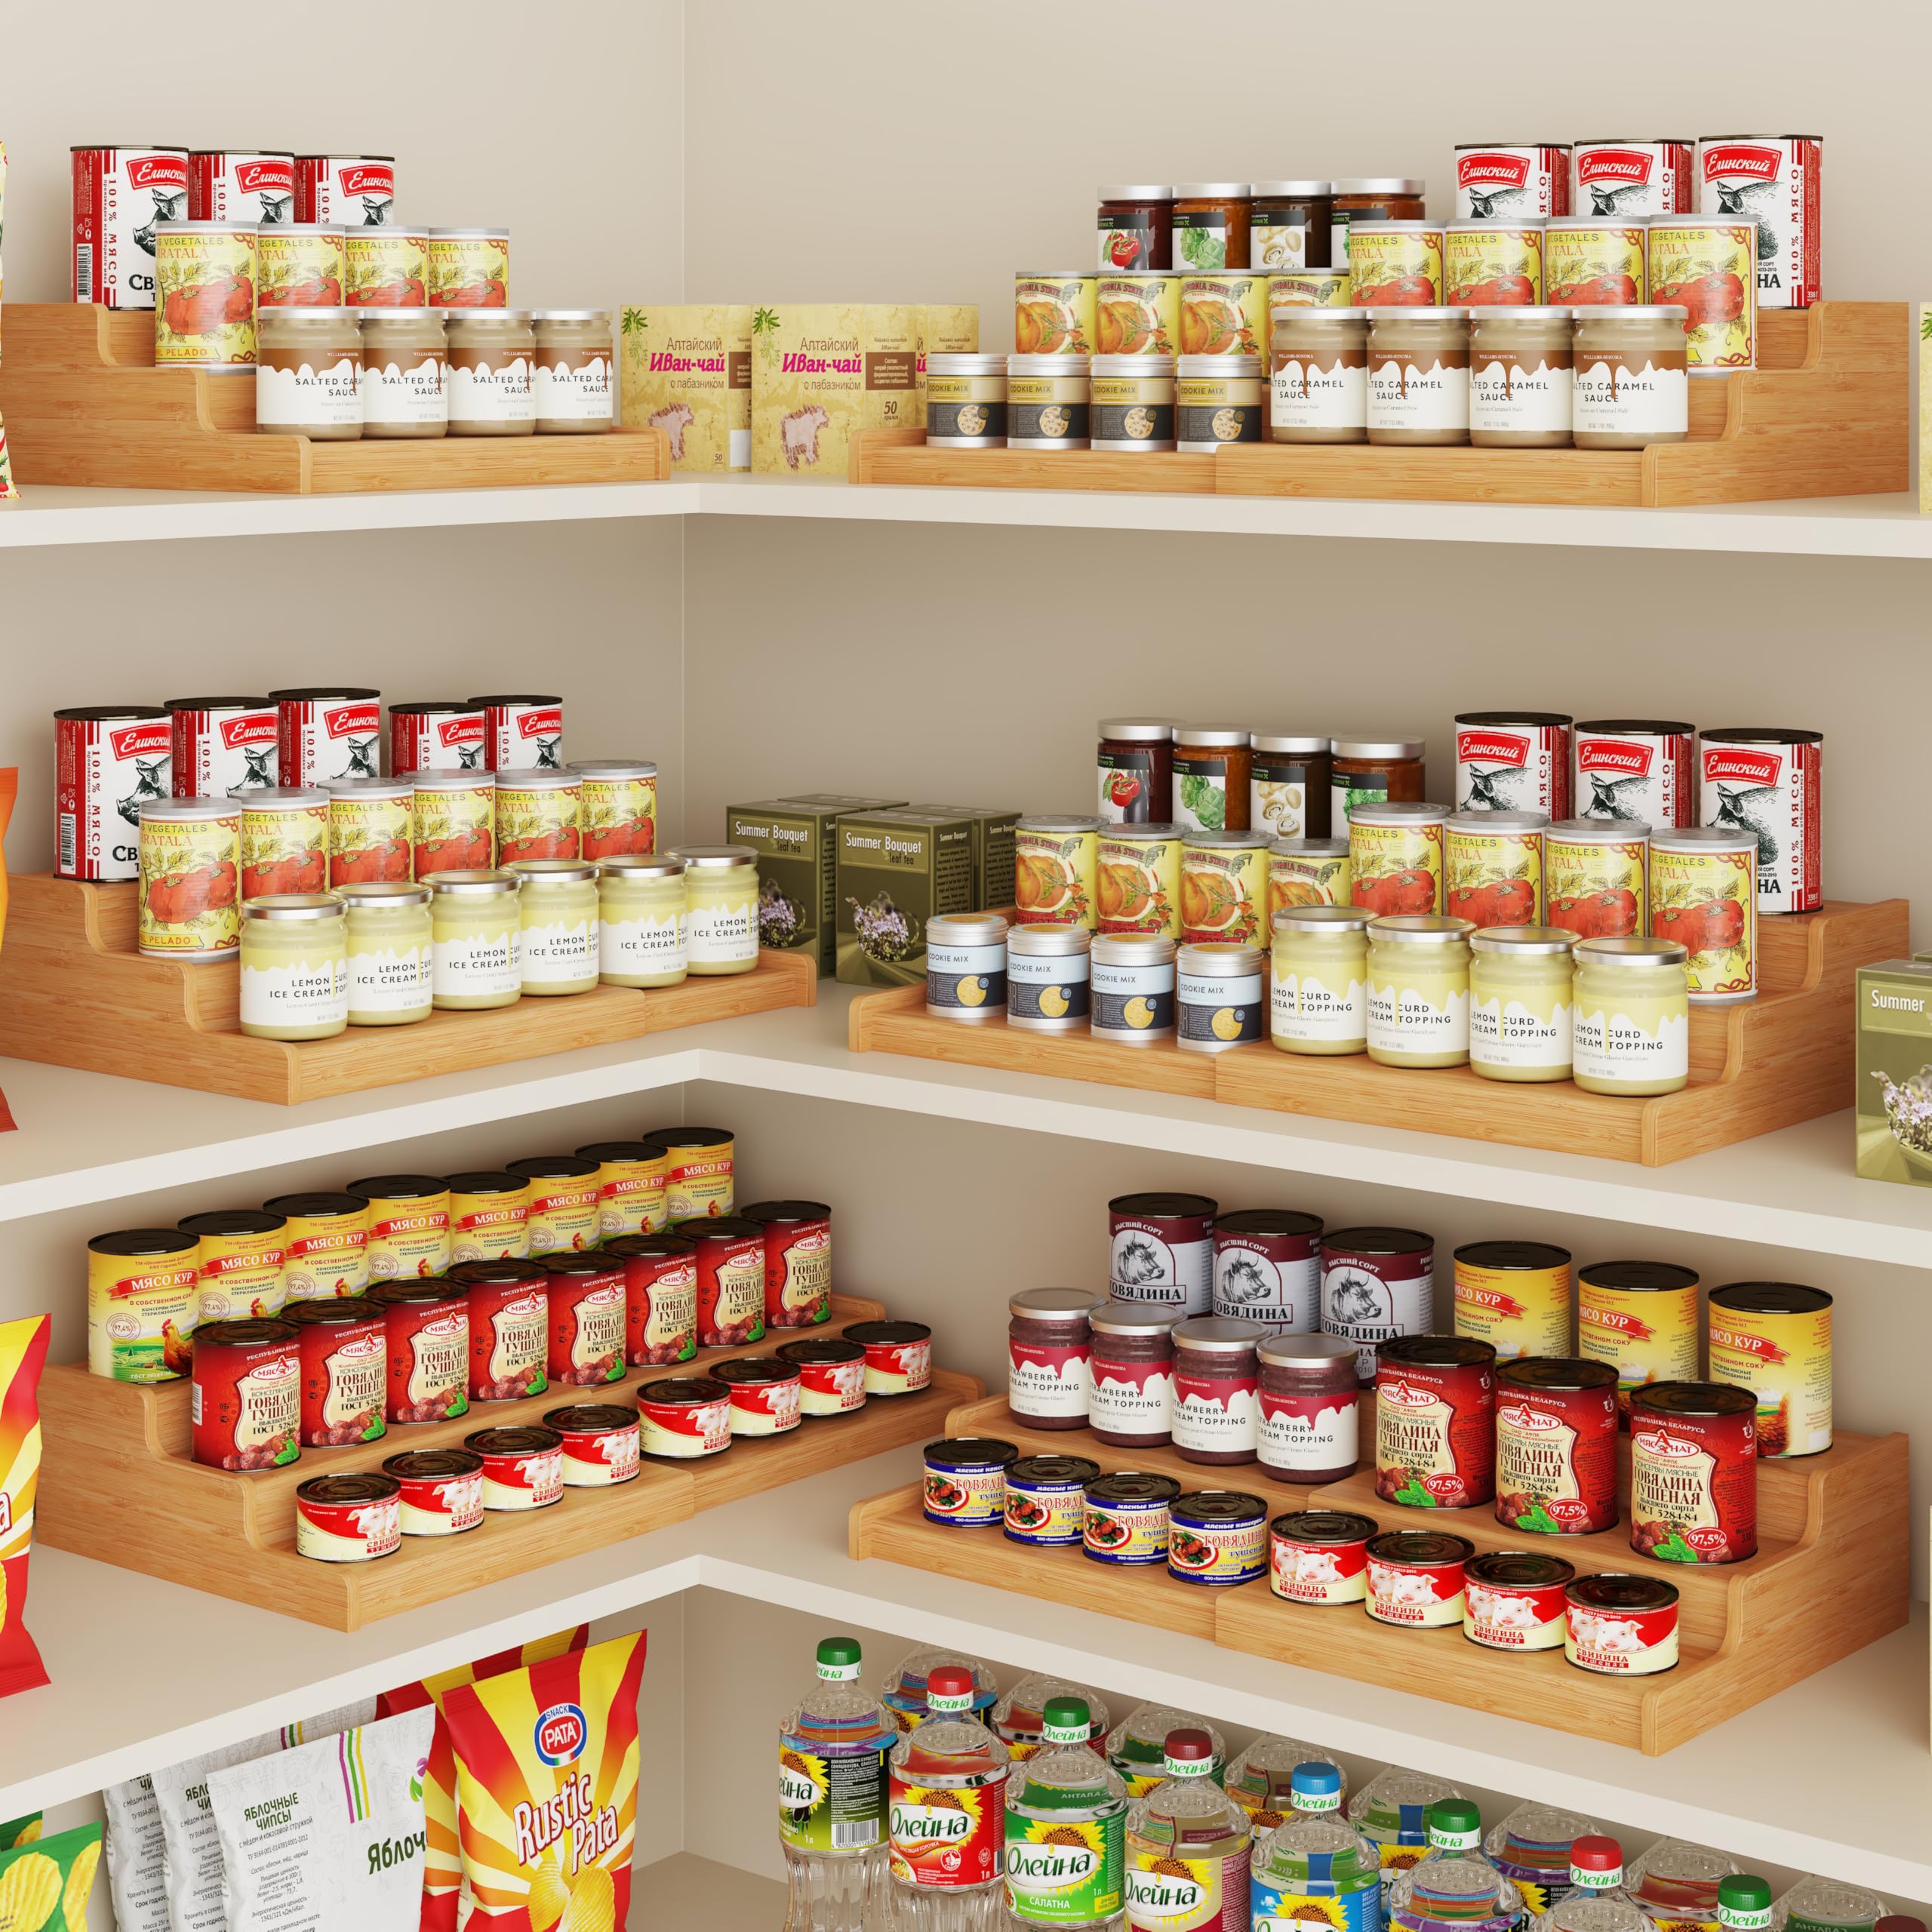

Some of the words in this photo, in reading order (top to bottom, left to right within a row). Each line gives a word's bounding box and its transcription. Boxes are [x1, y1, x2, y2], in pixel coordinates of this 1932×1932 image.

[1583, 158, 1642, 180] Елинский
[1708, 154, 1770, 175] Елинский
[1461, 161, 1519, 183] Елинский
[667, 337, 721, 352] Алтайский
[801, 337, 859, 352] Алтайский
[650, 352, 724, 373] Иван-чай
[782, 353, 862, 374] Иван-чай
[677, 380, 724, 389] лабазником
[811, 380, 860, 390] лабазником
[1492, 382, 1548, 390] CARAMEL
[1596, 383, 1654, 391] CARAMEL
[1585, 394, 1618, 402] SAUCE
[884, 401, 897, 414] 50
[1461, 736, 1521, 759] Елинский
[1582, 744, 1642, 769] Елинский
[92, 751, 100, 792] 100%
[1708, 755, 1770, 778] Елинский
[92, 806, 100, 857] МЯСО
[736, 821, 770, 838] Summer
[773, 826, 808, 843] Bouquet
[778, 842, 789, 852] leaf
[791, 844, 801, 853] tea
[846, 832, 881, 850] Summer
[885, 836, 921, 855] Bouquet
[890, 853, 901, 863] leaf
[903, 855, 914, 864] tea
[714, 918, 746, 928] LEMON
[641, 930, 674, 939] LEMON
[550, 937, 584, 946] LEMON
[471, 949, 506, 958] LEMON
[552, 946, 585, 955] CREAM
[379, 964, 416, 973] LEMON
[472, 960, 506, 968] CREAM
[1011, 963, 1033, 972] COOKIE
[292, 977, 329, 987] LEMON
[358, 976, 374, 984] ICE
[382, 974, 417, 983] CREAM
[1094, 973, 1117, 982] COOKIE
[270, 989, 287, 998] ICE
[294, 988, 331, 997] CREAM
[1181, 983, 1205, 992] COOKIE
[1872, 989, 1924, 1012] Summer
[1302, 1004, 1352, 1012] TOPPING
[1400, 1015, 1451, 1024] TOPPING
[1504, 1028, 1557, 1037] TOPPING
[1610, 1041, 1663, 1051] TOPPING
[684, 1164, 716, 1177] МЯСО
[718, 1161, 731, 1172] КУР
[617, 1180, 649, 1192] МЯСО
[651, 1177, 664, 1187] КУР
[547, 1195, 582, 1208] МЯСО
[583, 1192, 596, 1203] КУР
[389, 1218, 428, 1232] МЯСО
[429, 1214, 445, 1226] КУР
[475, 1211, 510, 1225] МЯСО
[511, 1208, 525, 1220] КУР
[1144, 1225, 1163, 1236] СОРТ
[306, 1236, 344, 1251] МЯСО
[346, 1233, 363, 1245] КУР
[1249, 1242, 1269, 1254] СОРТ
[221, 1255, 261, 1270] МЯСО
[263, 1252, 280, 1265] КУР
[1358, 1261, 1380, 1274] СОРТ
[131, 1275, 172, 1291] МЯСО
[174, 1272, 192, 1284] КУР
[1476, 1292, 1501, 1306] КУР
[1735, 1336, 1761, 1350] КУР
[1409, 1374, 1442, 1383] БЕЛАРУСЬ
[1033, 1381, 1078, 1392] TOPPING
[1113, 1398, 1161, 1407] TOPPING
[1531, 1397, 1566, 1407] БЕЛАРУСЬ
[1668, 1421, 1705, 1433] БЕЛАРУСЬ
[1284, 1433, 1334, 1443] TOPPING
[1429, 1479, 1462, 1491] 97,5%
[1552, 1504, 1586, 1516] 97,5%
[1657, 1512, 1697, 1521] 5284-84
[1690, 1532, 1725, 1545] 97,5%
[1280, 1580, 1326, 1593] СВИНИНА
[1375, 1601, 1423, 1615] СВИНИНА
[1474, 1624, 1524, 1638] СВИНИНА
[1577, 1647, 1628, 1662] СВИНИНА
[928, 1694, 970, 1709] Олейна
[546, 1706, 568, 1719] SNACK
[545, 1721, 577, 1749] PATA
[1044, 1727, 1086, 1740] Олейна
[1165, 1758, 1208, 1774] Олейна
[245, 1792, 299, 1821] ЯБЛОЧНЫЕ
[1292, 1792, 1337, 1808] Олейна
[256, 1810, 291, 1831] ЧИПСЫ
[514, 1772, 592, 1866] Rustic
[891, 1807, 967, 1838] Олейна
[571, 1805, 619, 1875] Pata
[1008, 1847, 1090, 1876] Олейна
[1572, 1869, 1620, 1886] Олейна
[1029, 1897, 1069, 1909] САЛАТНА
[1720, 1908, 1769, 1925] Олейна
